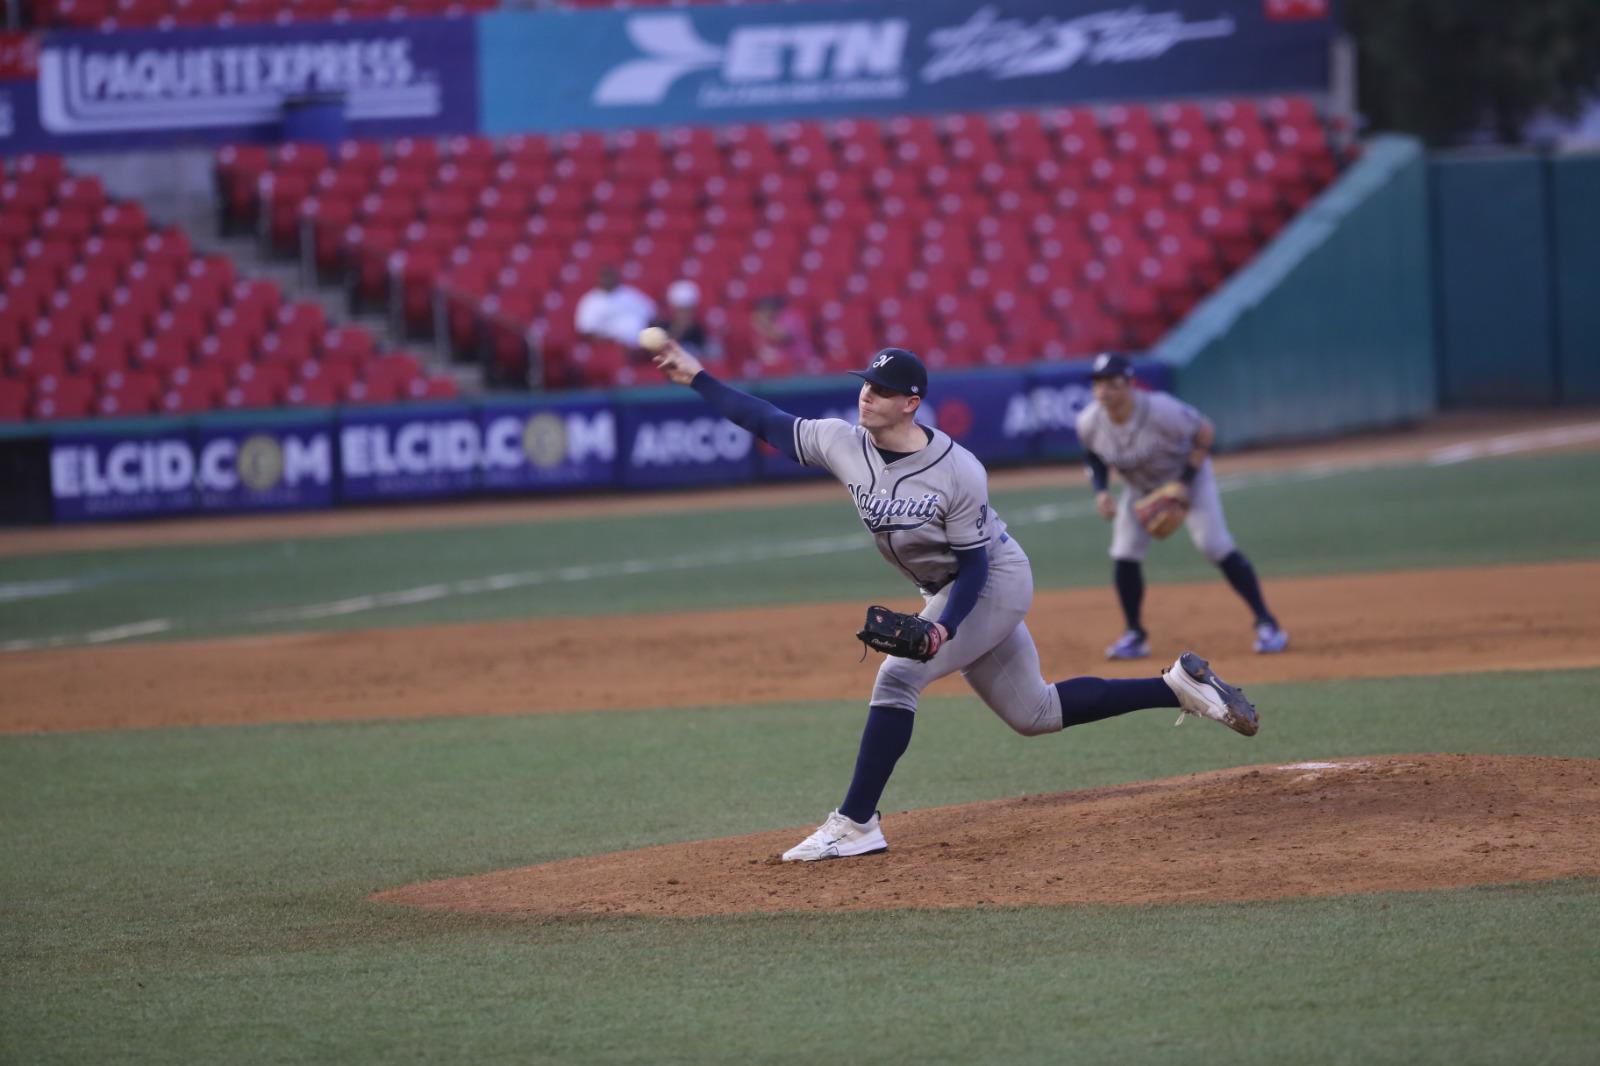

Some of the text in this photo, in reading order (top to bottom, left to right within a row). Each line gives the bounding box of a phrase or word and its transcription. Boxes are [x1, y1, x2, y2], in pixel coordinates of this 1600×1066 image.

[84, 38, 414, 98] PAQUETEXPRESS
[723, 20, 908, 83] ETN
[1003, 383, 1098, 438] ARC
[630, 417, 752, 468] ARCO
